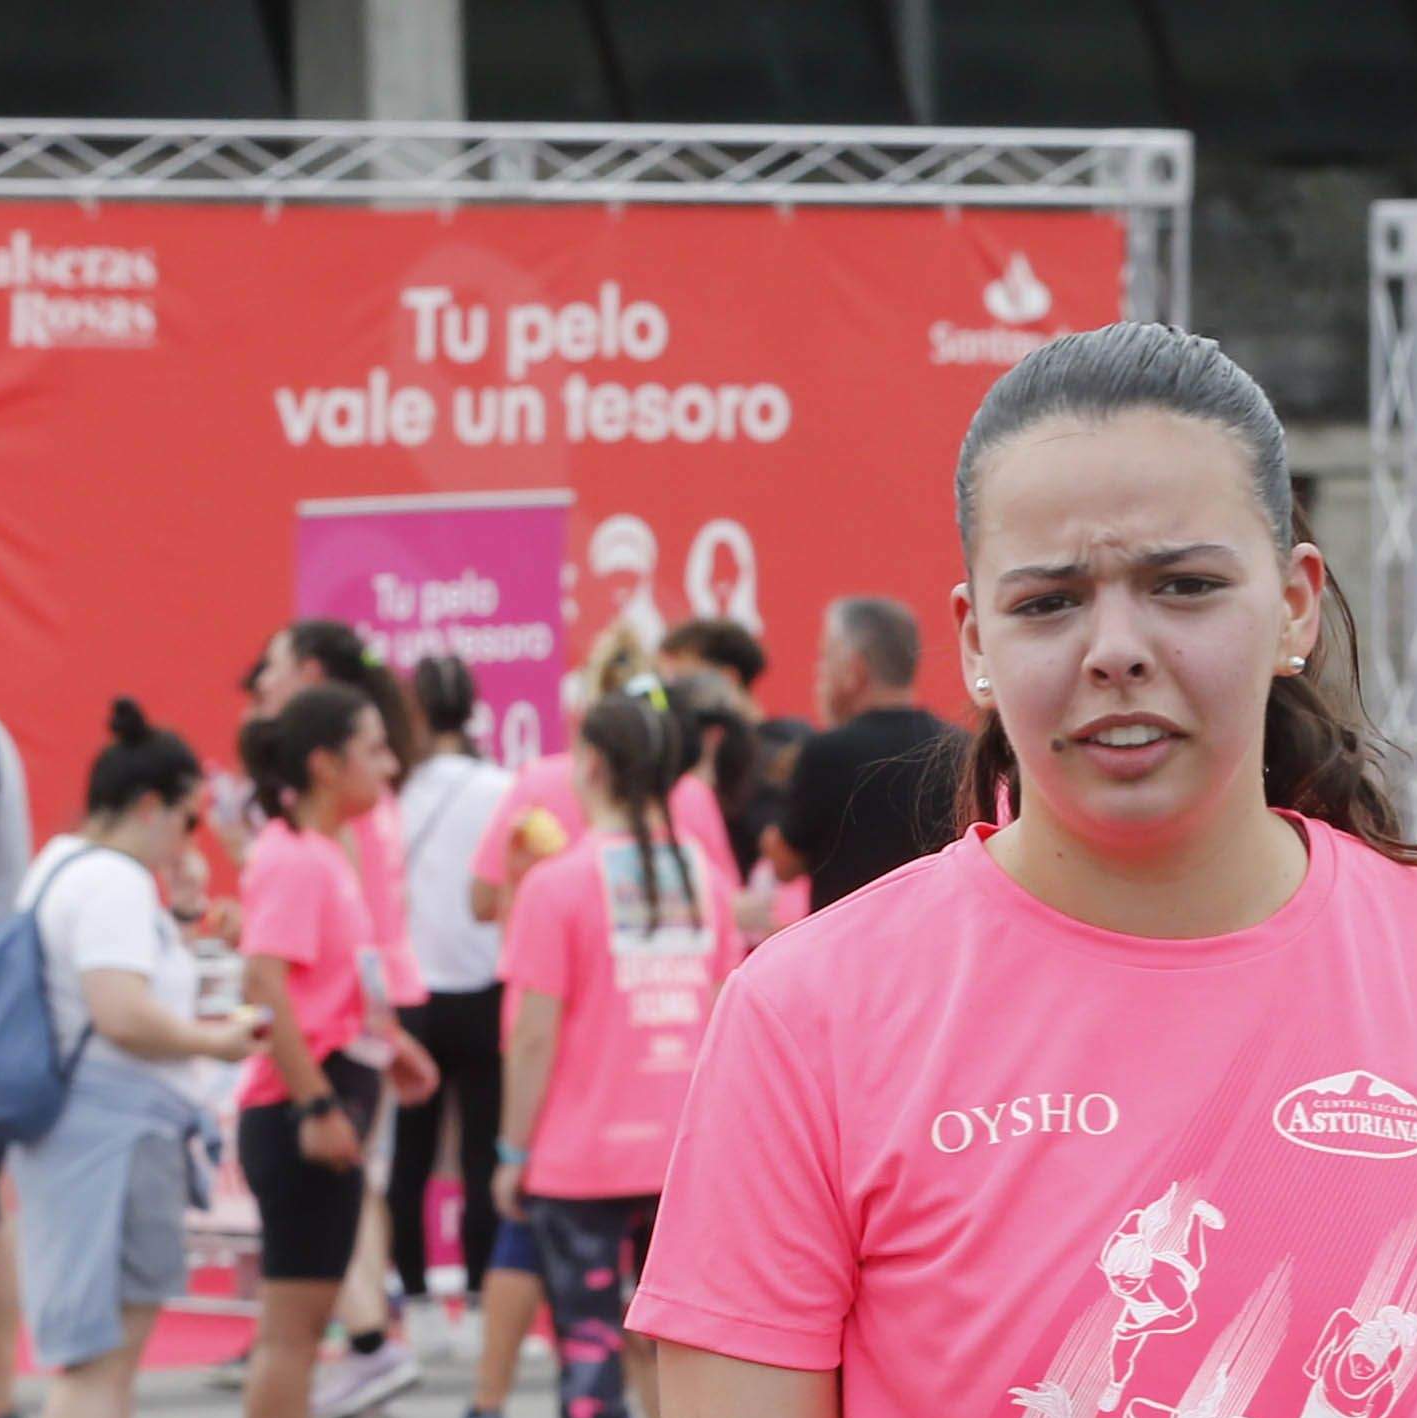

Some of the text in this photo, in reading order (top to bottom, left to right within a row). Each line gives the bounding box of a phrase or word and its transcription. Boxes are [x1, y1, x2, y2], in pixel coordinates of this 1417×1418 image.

[400, 280, 669, 380] Tu pelo
[275, 366, 792, 447] vale un tesoro
[930, 1092, 1120, 1154] OYSHO
